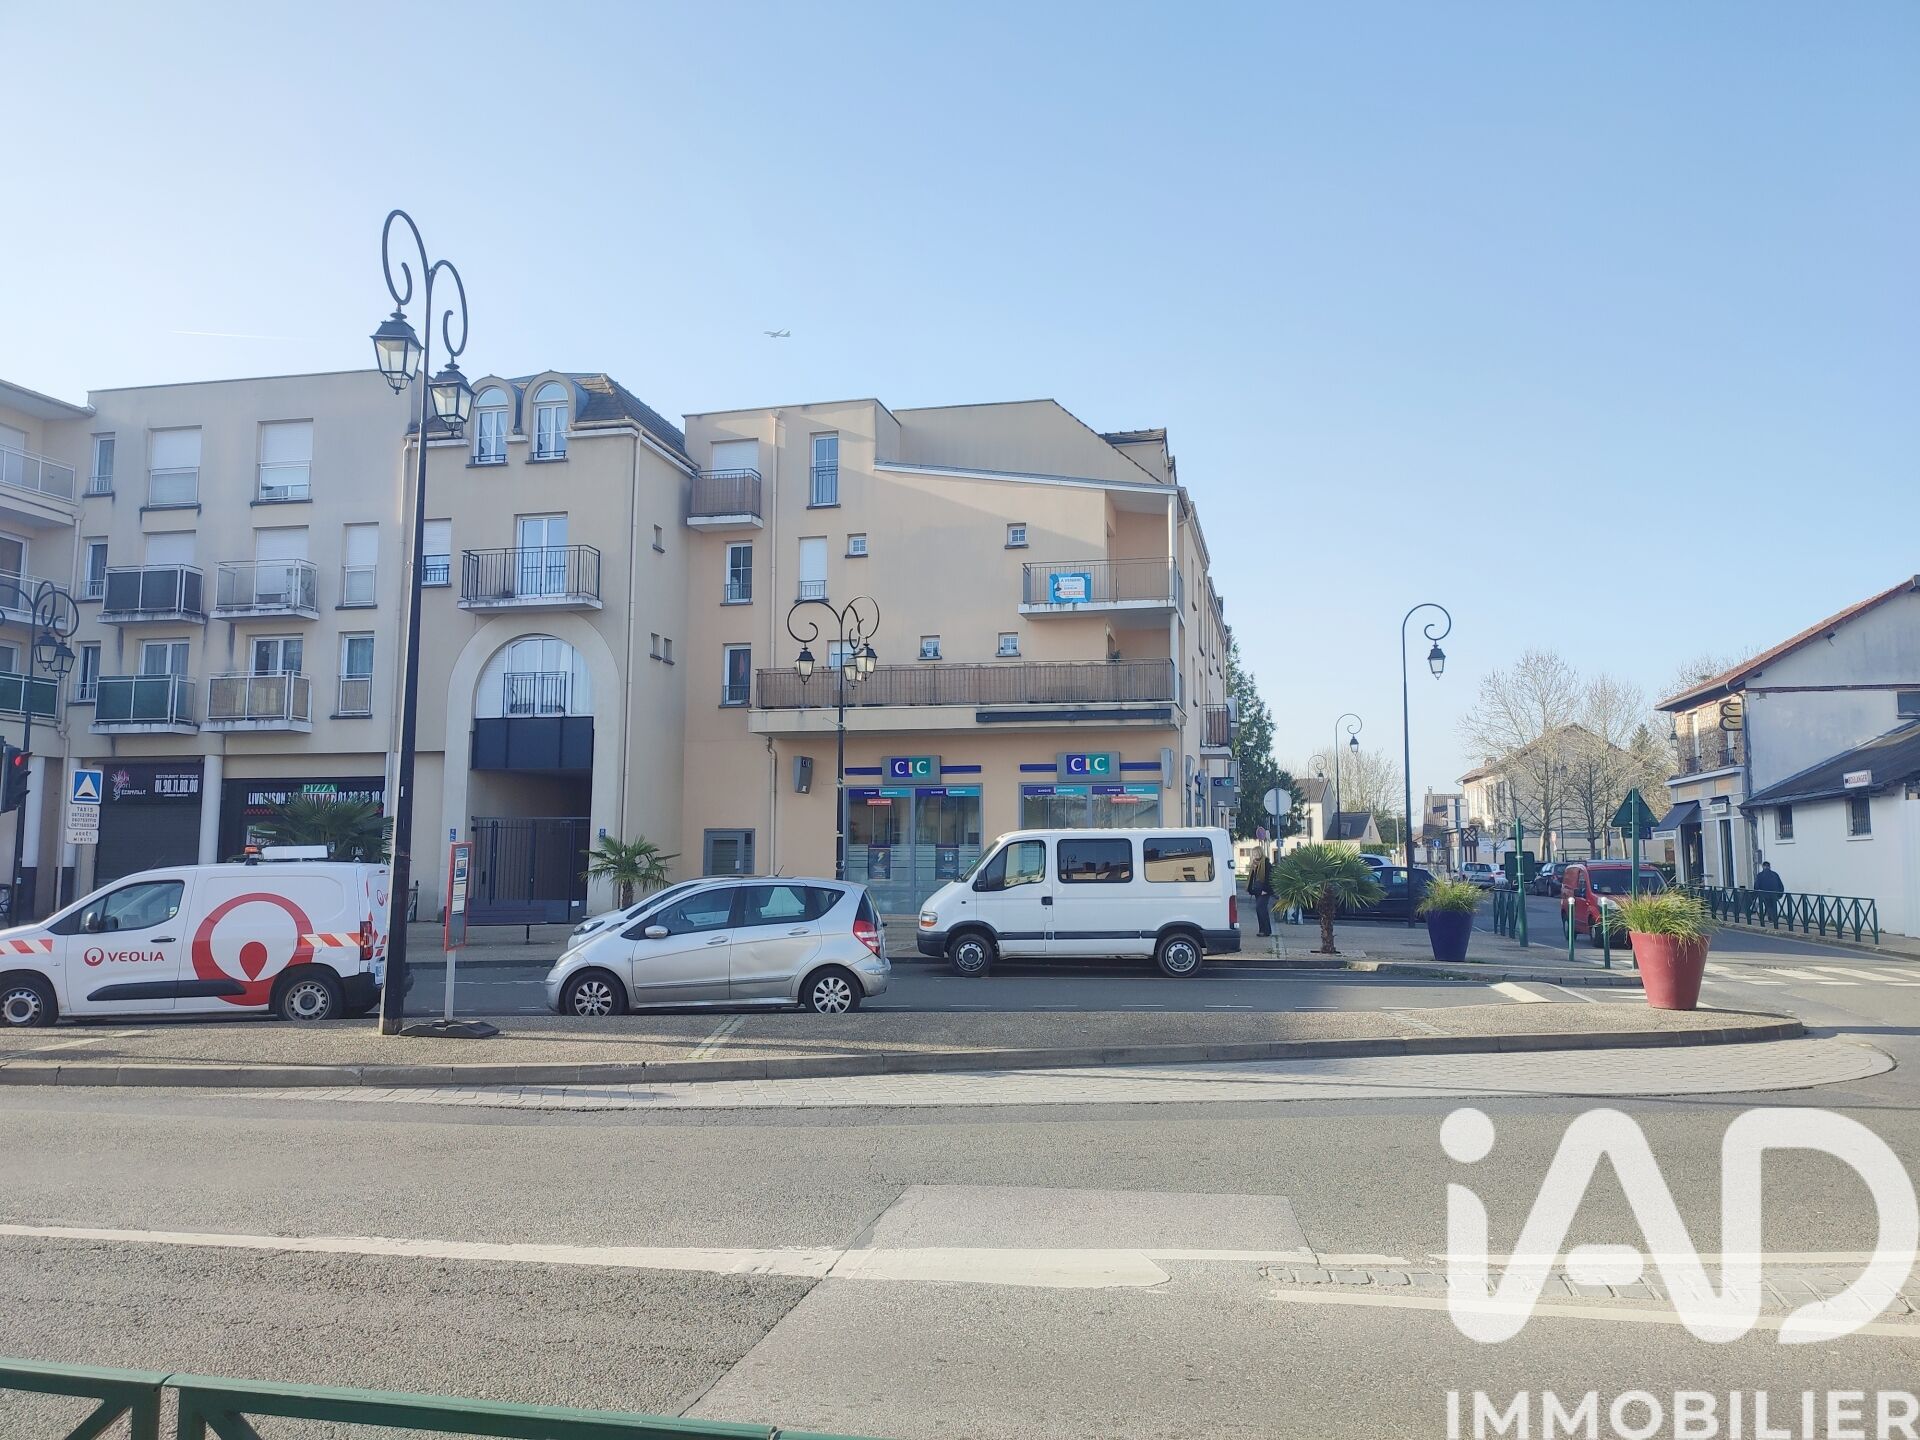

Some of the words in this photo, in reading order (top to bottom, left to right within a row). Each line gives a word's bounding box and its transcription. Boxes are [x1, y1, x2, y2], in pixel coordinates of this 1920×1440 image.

[894, 761, 927, 774] CIC
[1070, 757, 1105, 771] CIC
[303, 784, 336, 793] PIZZA
[108, 951, 165, 962] VEOLIA
